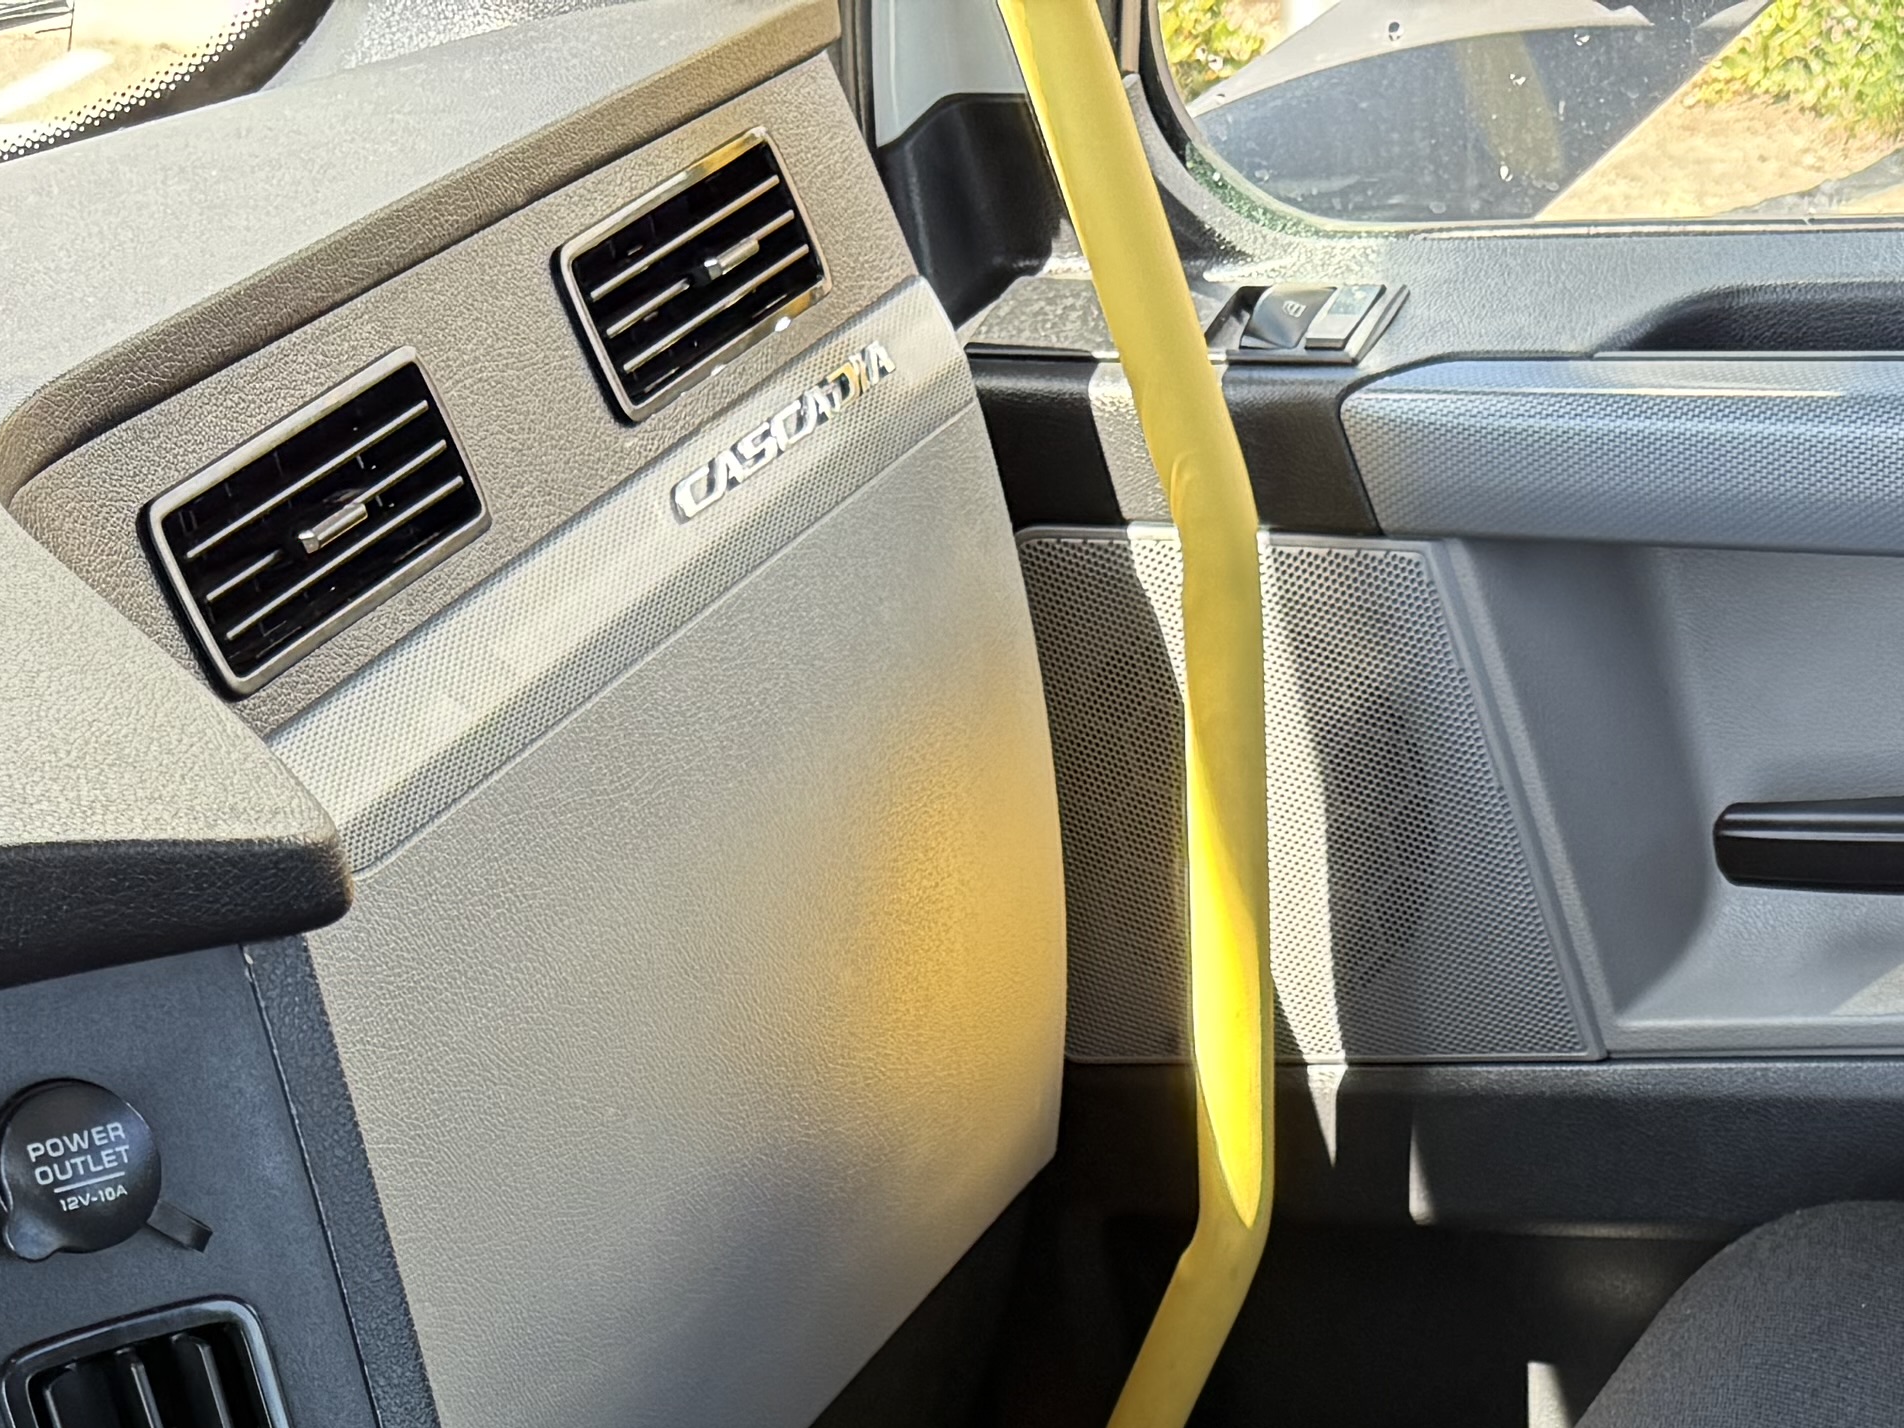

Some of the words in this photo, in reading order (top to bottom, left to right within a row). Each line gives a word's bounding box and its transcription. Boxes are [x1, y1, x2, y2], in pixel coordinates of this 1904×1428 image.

[672, 341, 896, 522] CASCADIA
[26, 1122, 126, 1162] POWER
[34, 1145, 130, 1186] OUTLET
[59, 1184, 128, 1212] 12V-10A
